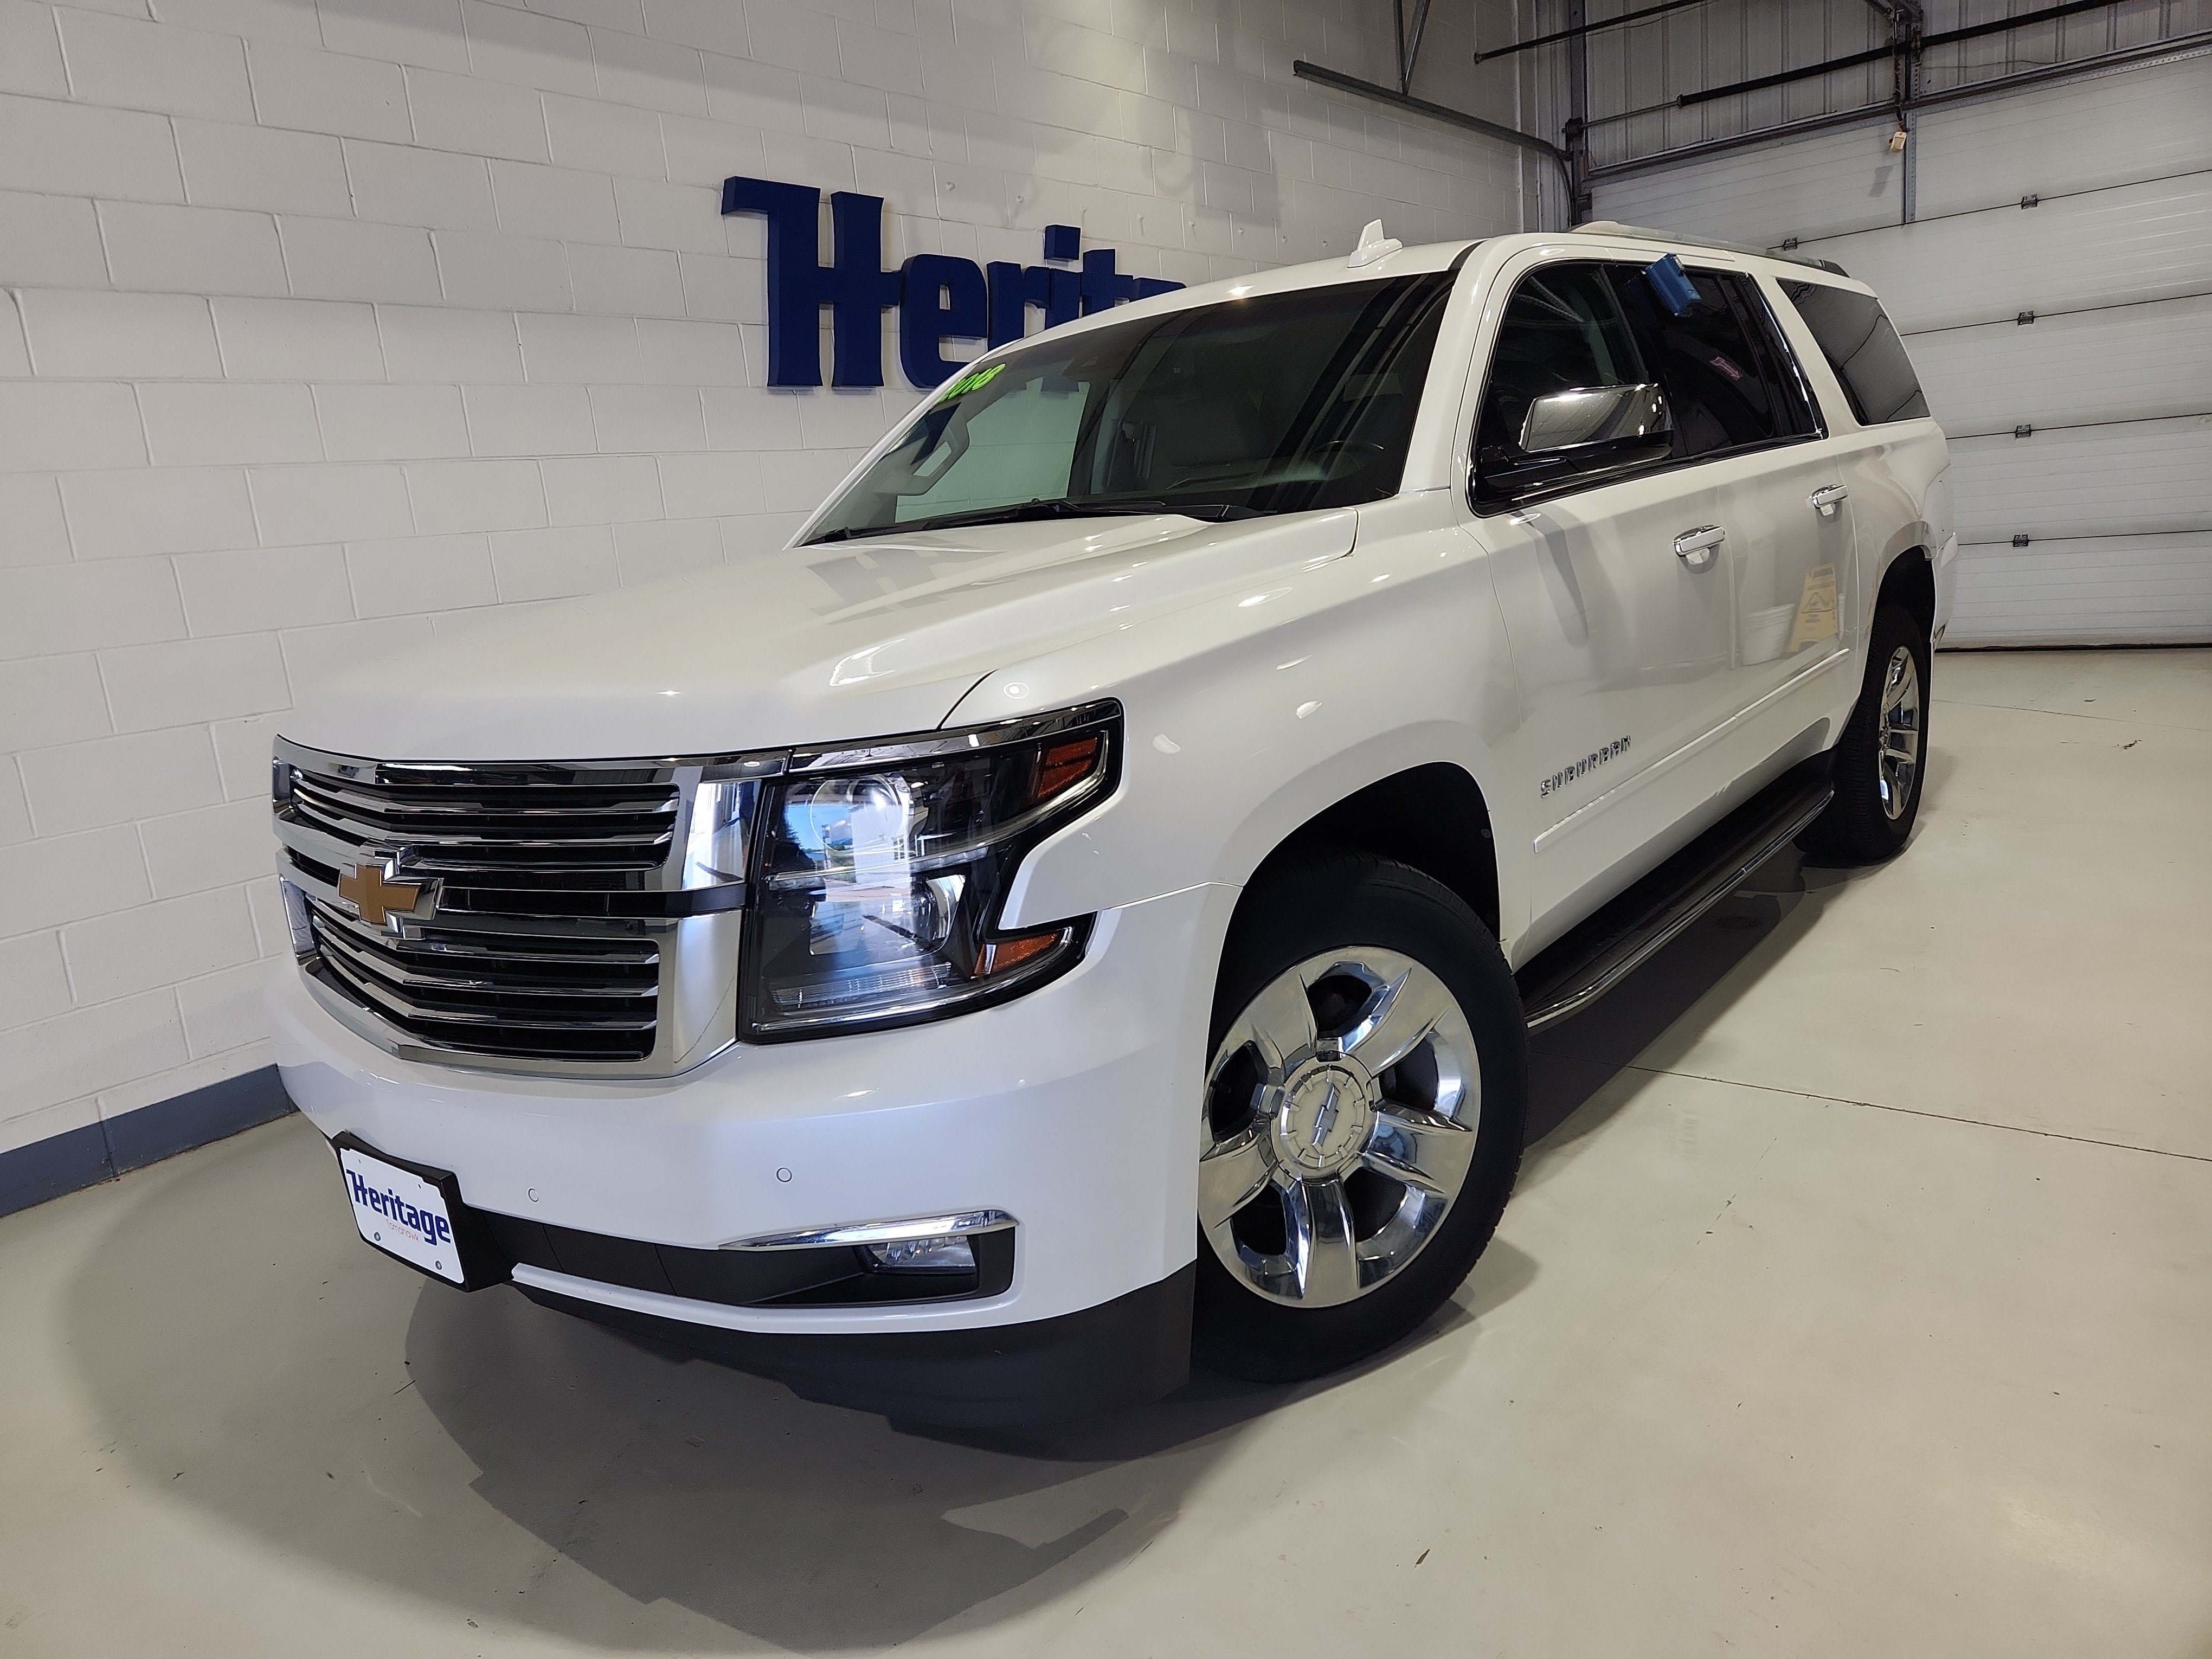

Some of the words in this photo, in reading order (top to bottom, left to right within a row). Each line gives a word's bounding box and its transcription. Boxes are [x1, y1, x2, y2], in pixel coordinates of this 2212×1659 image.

[721, 176, 1187, 389] Herit
[1540, 735, 1631, 799] SUBURBAN
[345, 1168, 452, 1246] Heritage
